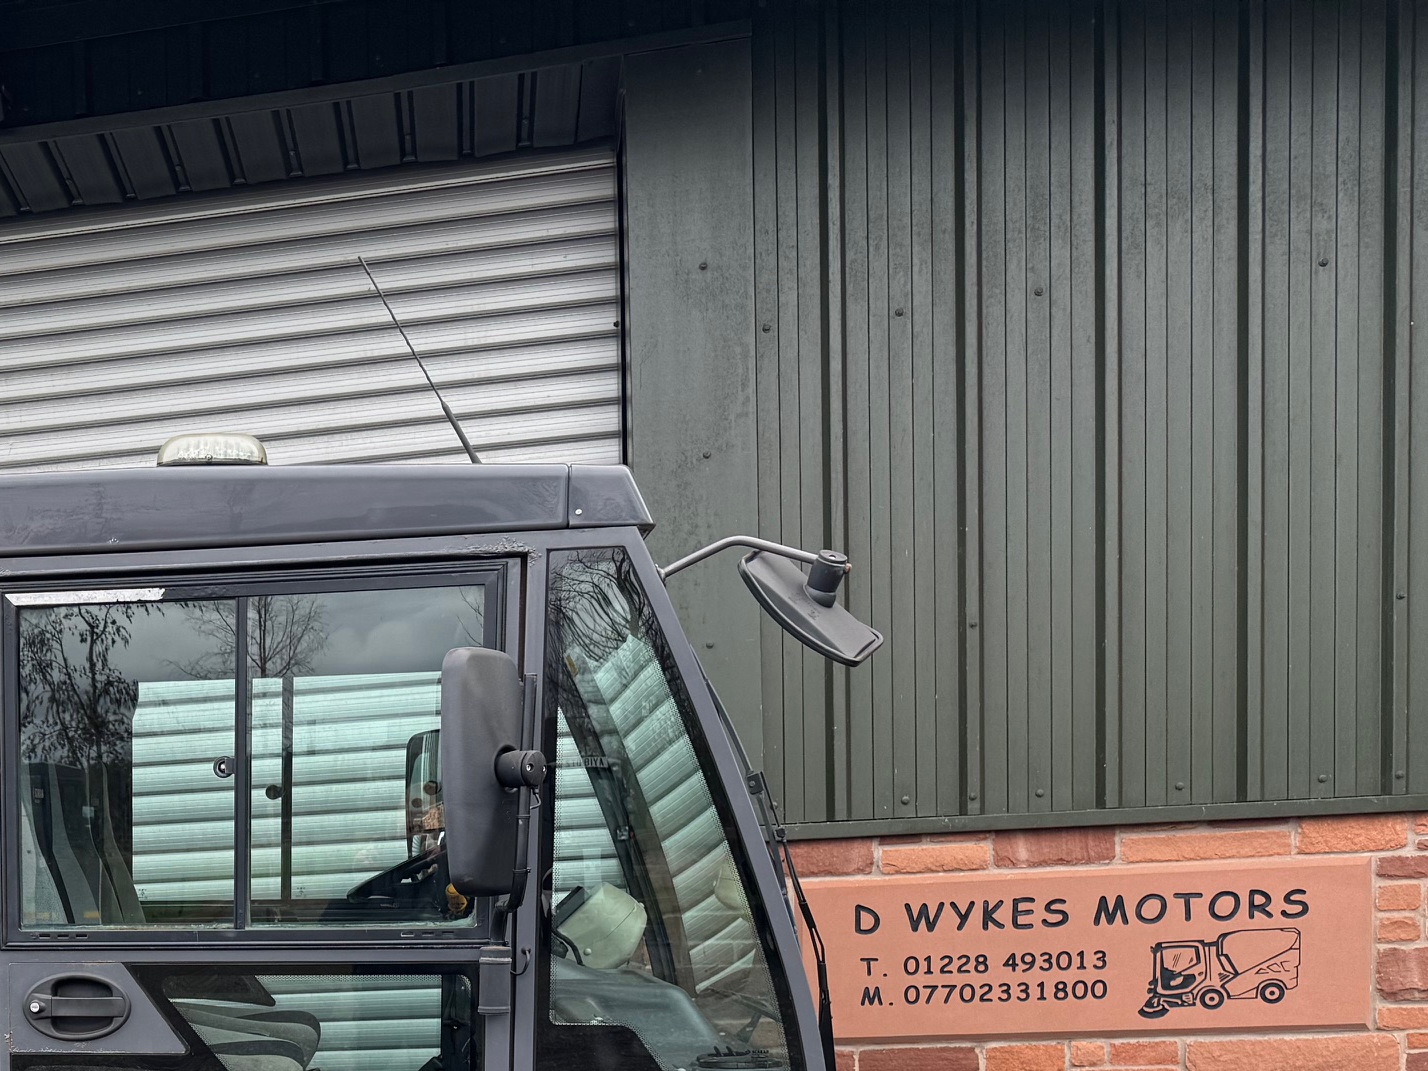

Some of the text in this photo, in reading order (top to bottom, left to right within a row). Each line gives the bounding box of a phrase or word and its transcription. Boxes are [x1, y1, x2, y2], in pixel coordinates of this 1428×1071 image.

[854, 888, 1310, 935] D WYKES MOTORS
[859, 949, 1107, 978] T. 01228 493013
[860, 979, 1108, 1007] M. 07702331800
